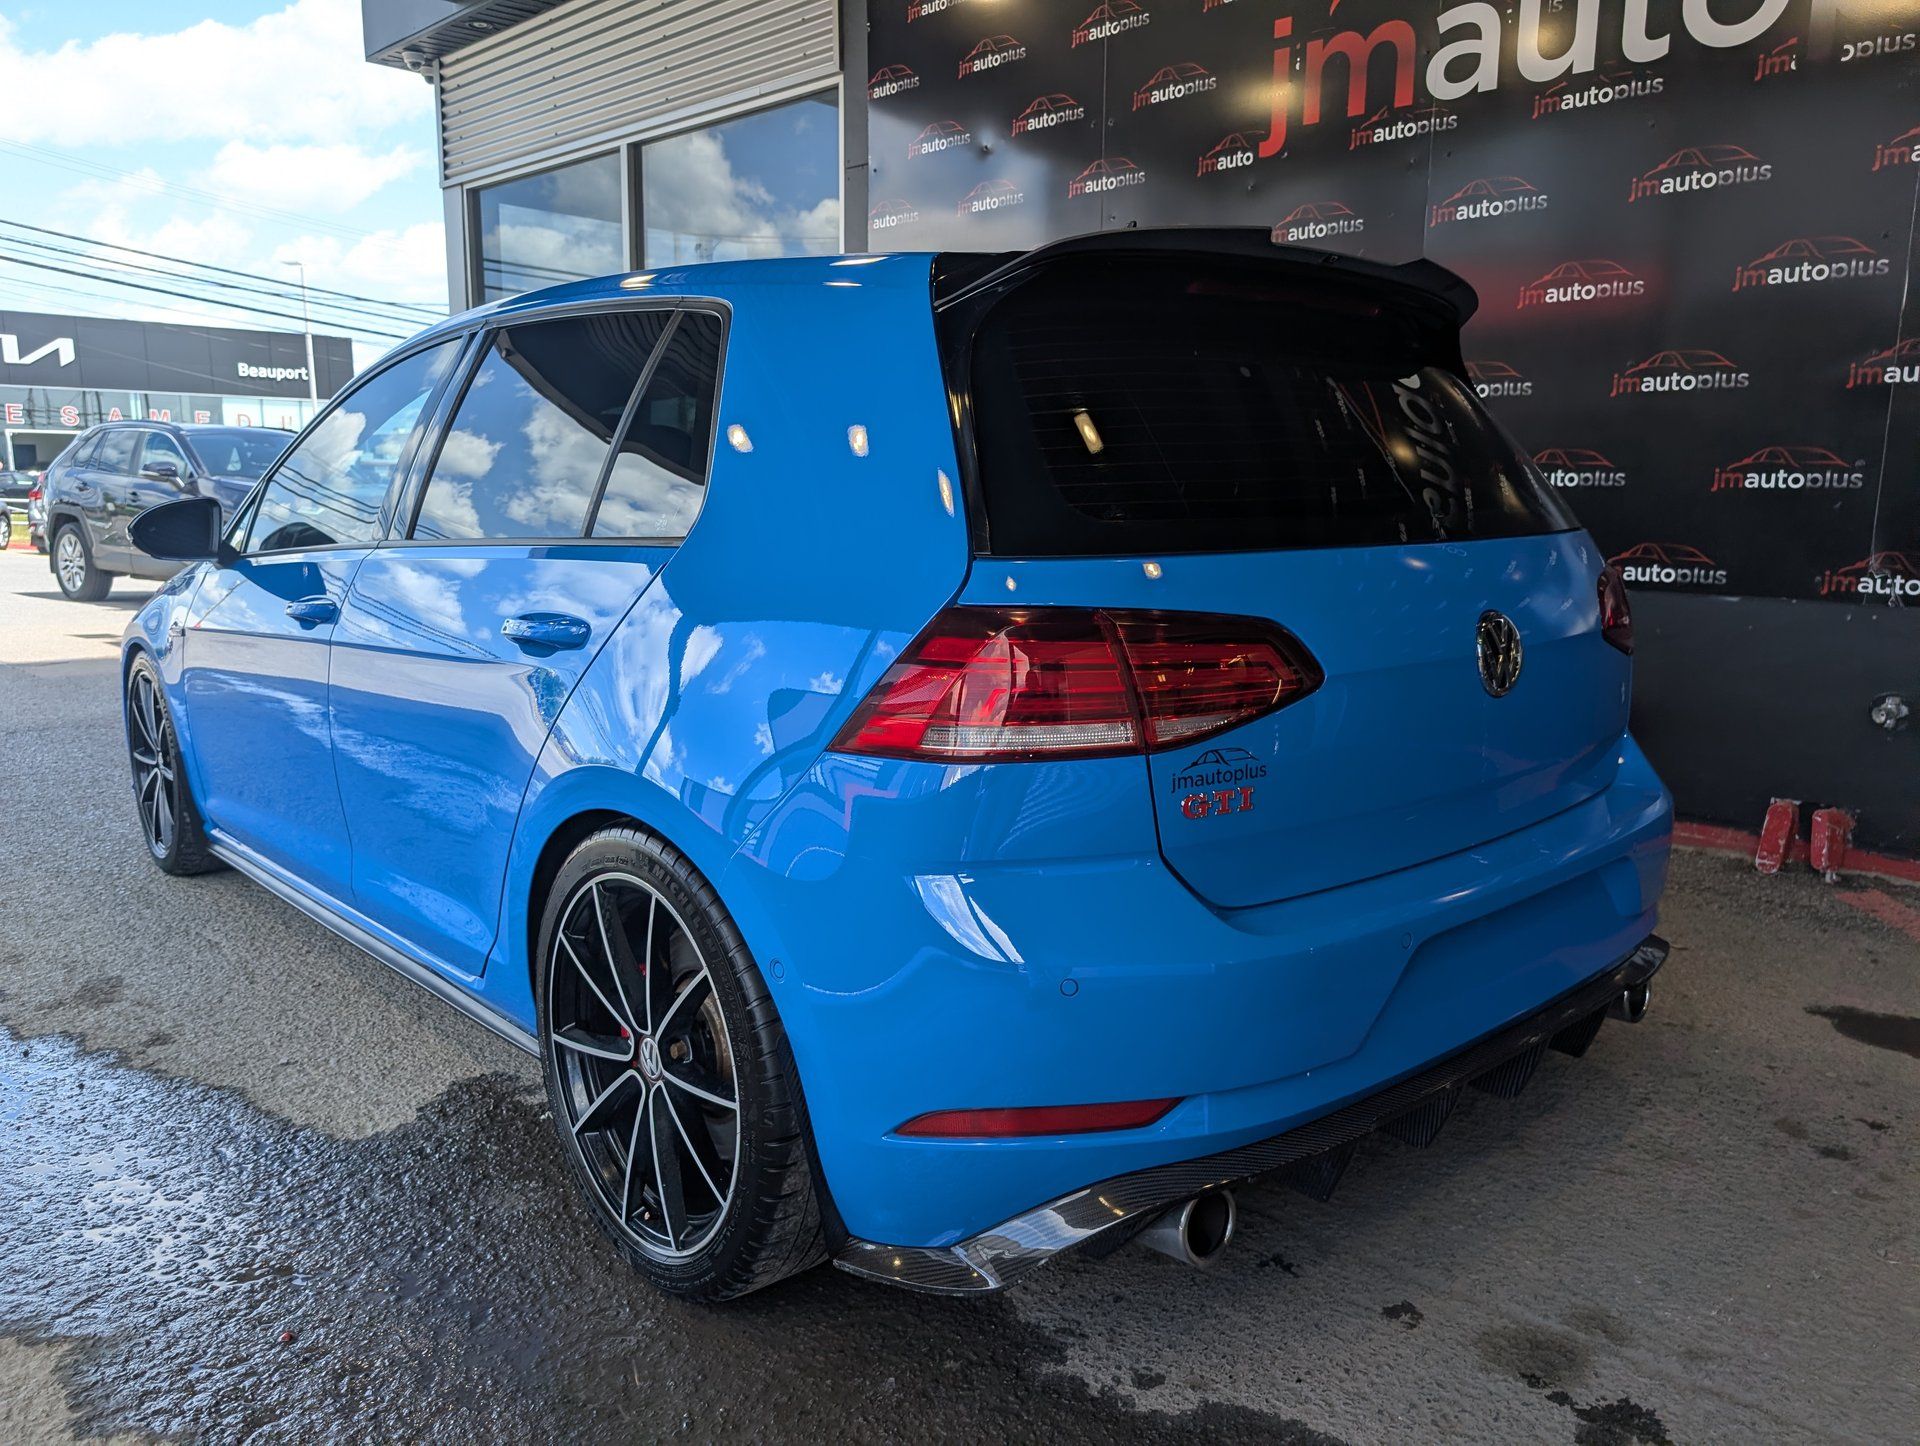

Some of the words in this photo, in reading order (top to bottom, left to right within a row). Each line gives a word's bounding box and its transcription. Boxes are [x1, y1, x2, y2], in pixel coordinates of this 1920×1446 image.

[1071, 12, 1150, 48] jmautoplus
[957, 47, 1027, 80] jmautoplus
[1132, 76, 1217, 112] jmautoplus
[1531, 76, 1664, 119] jmautoplus
[1011, 106, 1085, 137] jmautoplus
[1349, 114, 1458, 151] jmautoplus
[907, 133, 971, 160] jmautoplus
[1068, 170, 1146, 199] jmautoplus
[1628, 163, 1773, 203] jmautoplus
[956, 192, 1025, 218] jmautoplus
[1430, 194, 1548, 228] jmautoplus
[1732, 258, 1889, 293] jmautoplus
[1517, 279, 1645, 310] jmautoplus
[237, 362, 309, 382] Beauport
[1609, 371, 1750, 398] jmautoplus
[1710, 468, 1864, 493] jmautoplus
[1171, 763, 1268, 793] jmautoplus
[1181, 786, 1255, 820] GTI
[652, 863, 718, 957] MICHELIN
